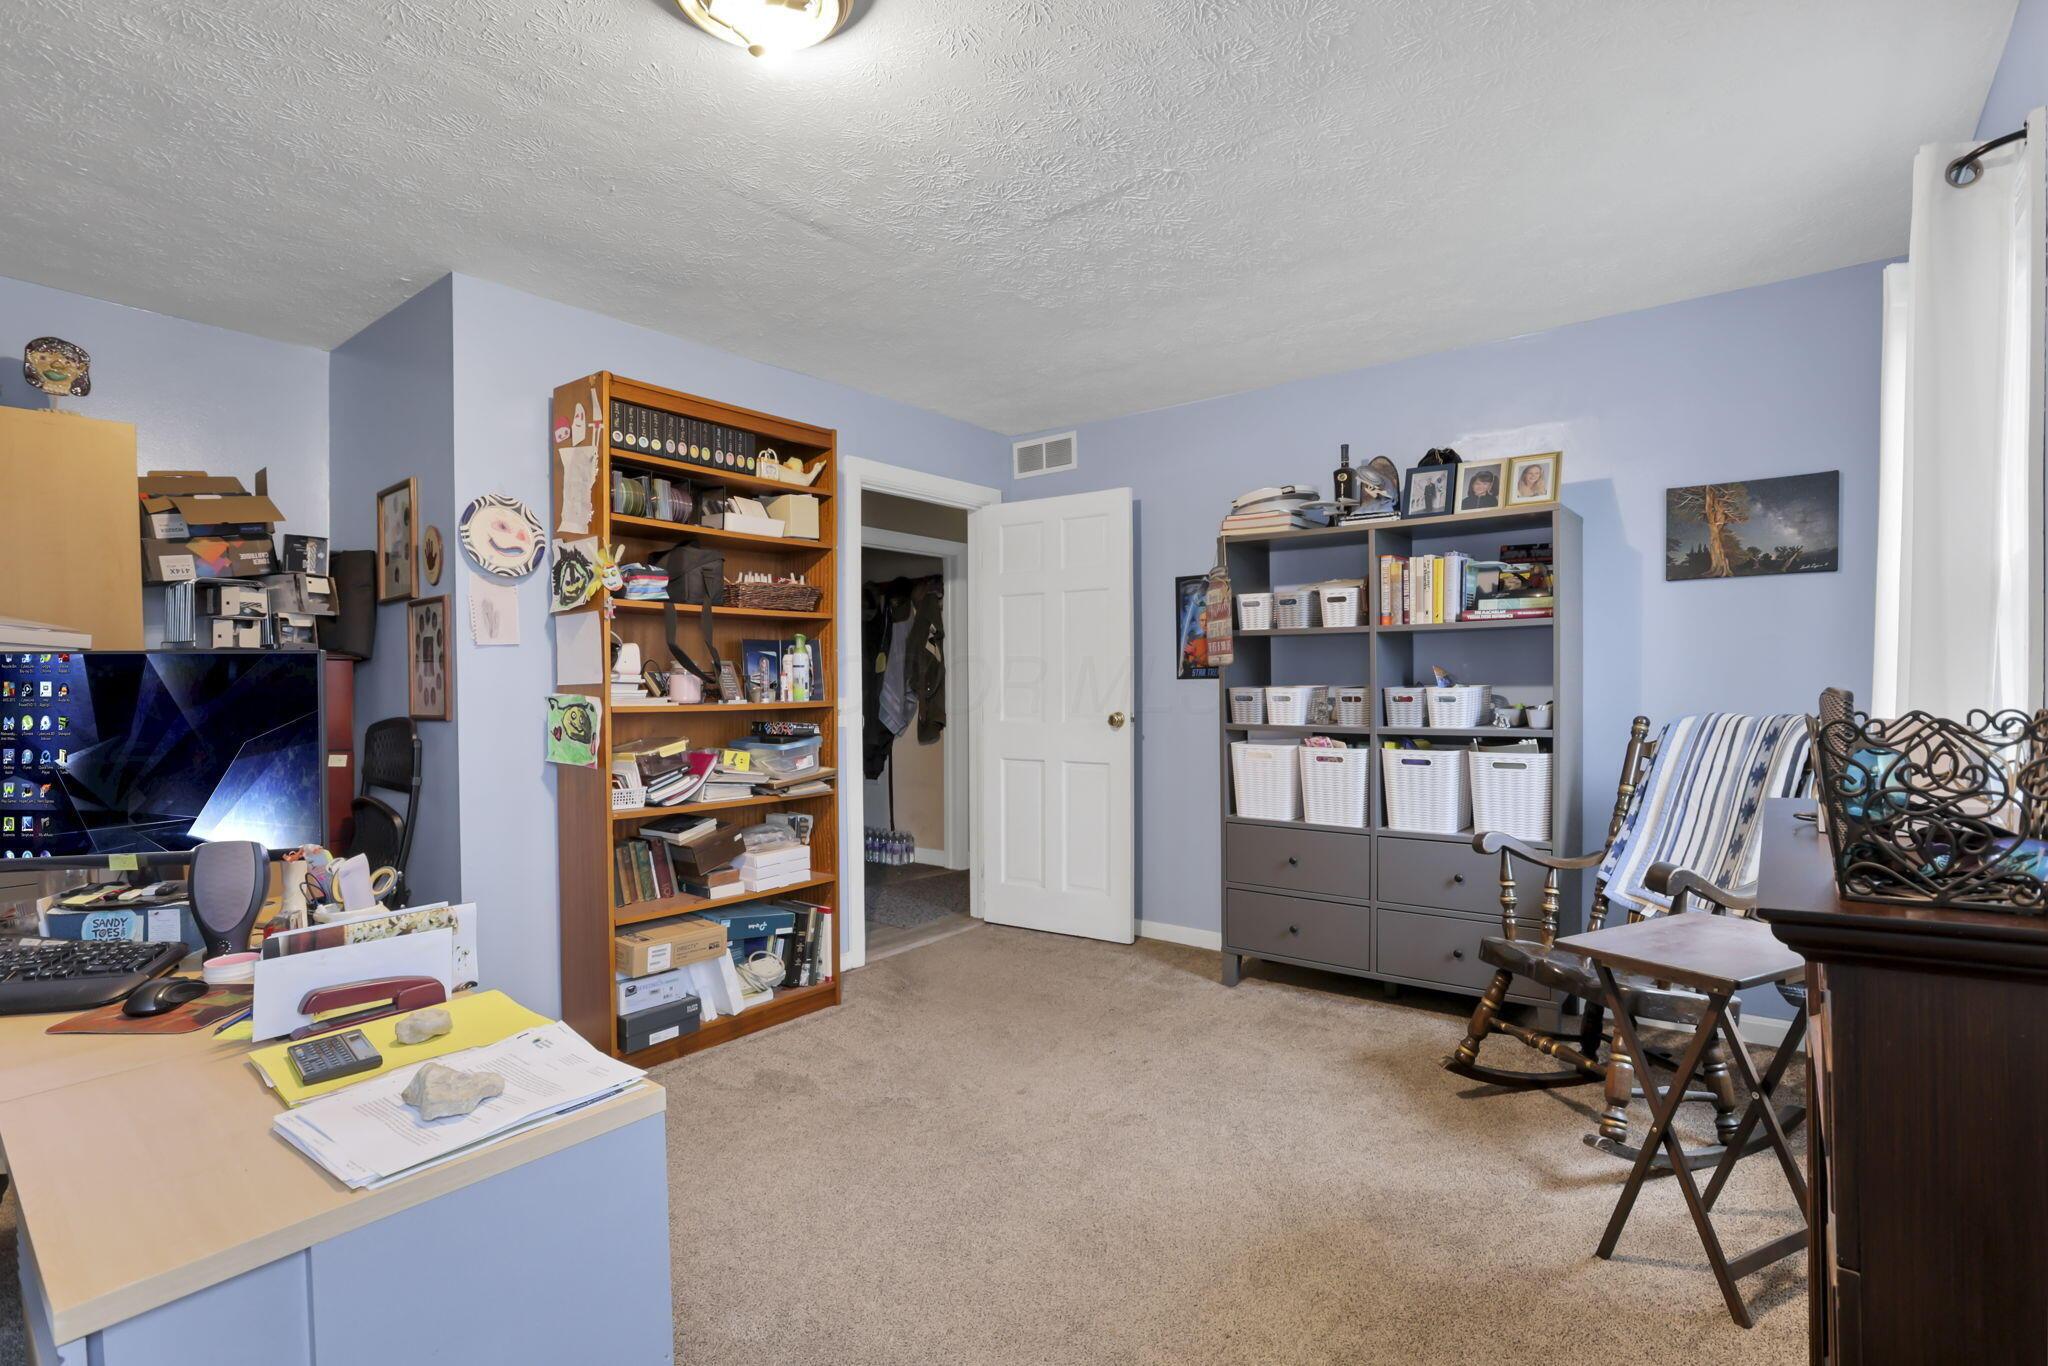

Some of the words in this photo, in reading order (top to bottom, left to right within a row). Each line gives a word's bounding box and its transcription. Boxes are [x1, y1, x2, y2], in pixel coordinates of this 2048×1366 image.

[169, 567, 191, 575] 414X
[92, 918, 128, 928] SANDY
[92, 928, 120, 937] TOES
